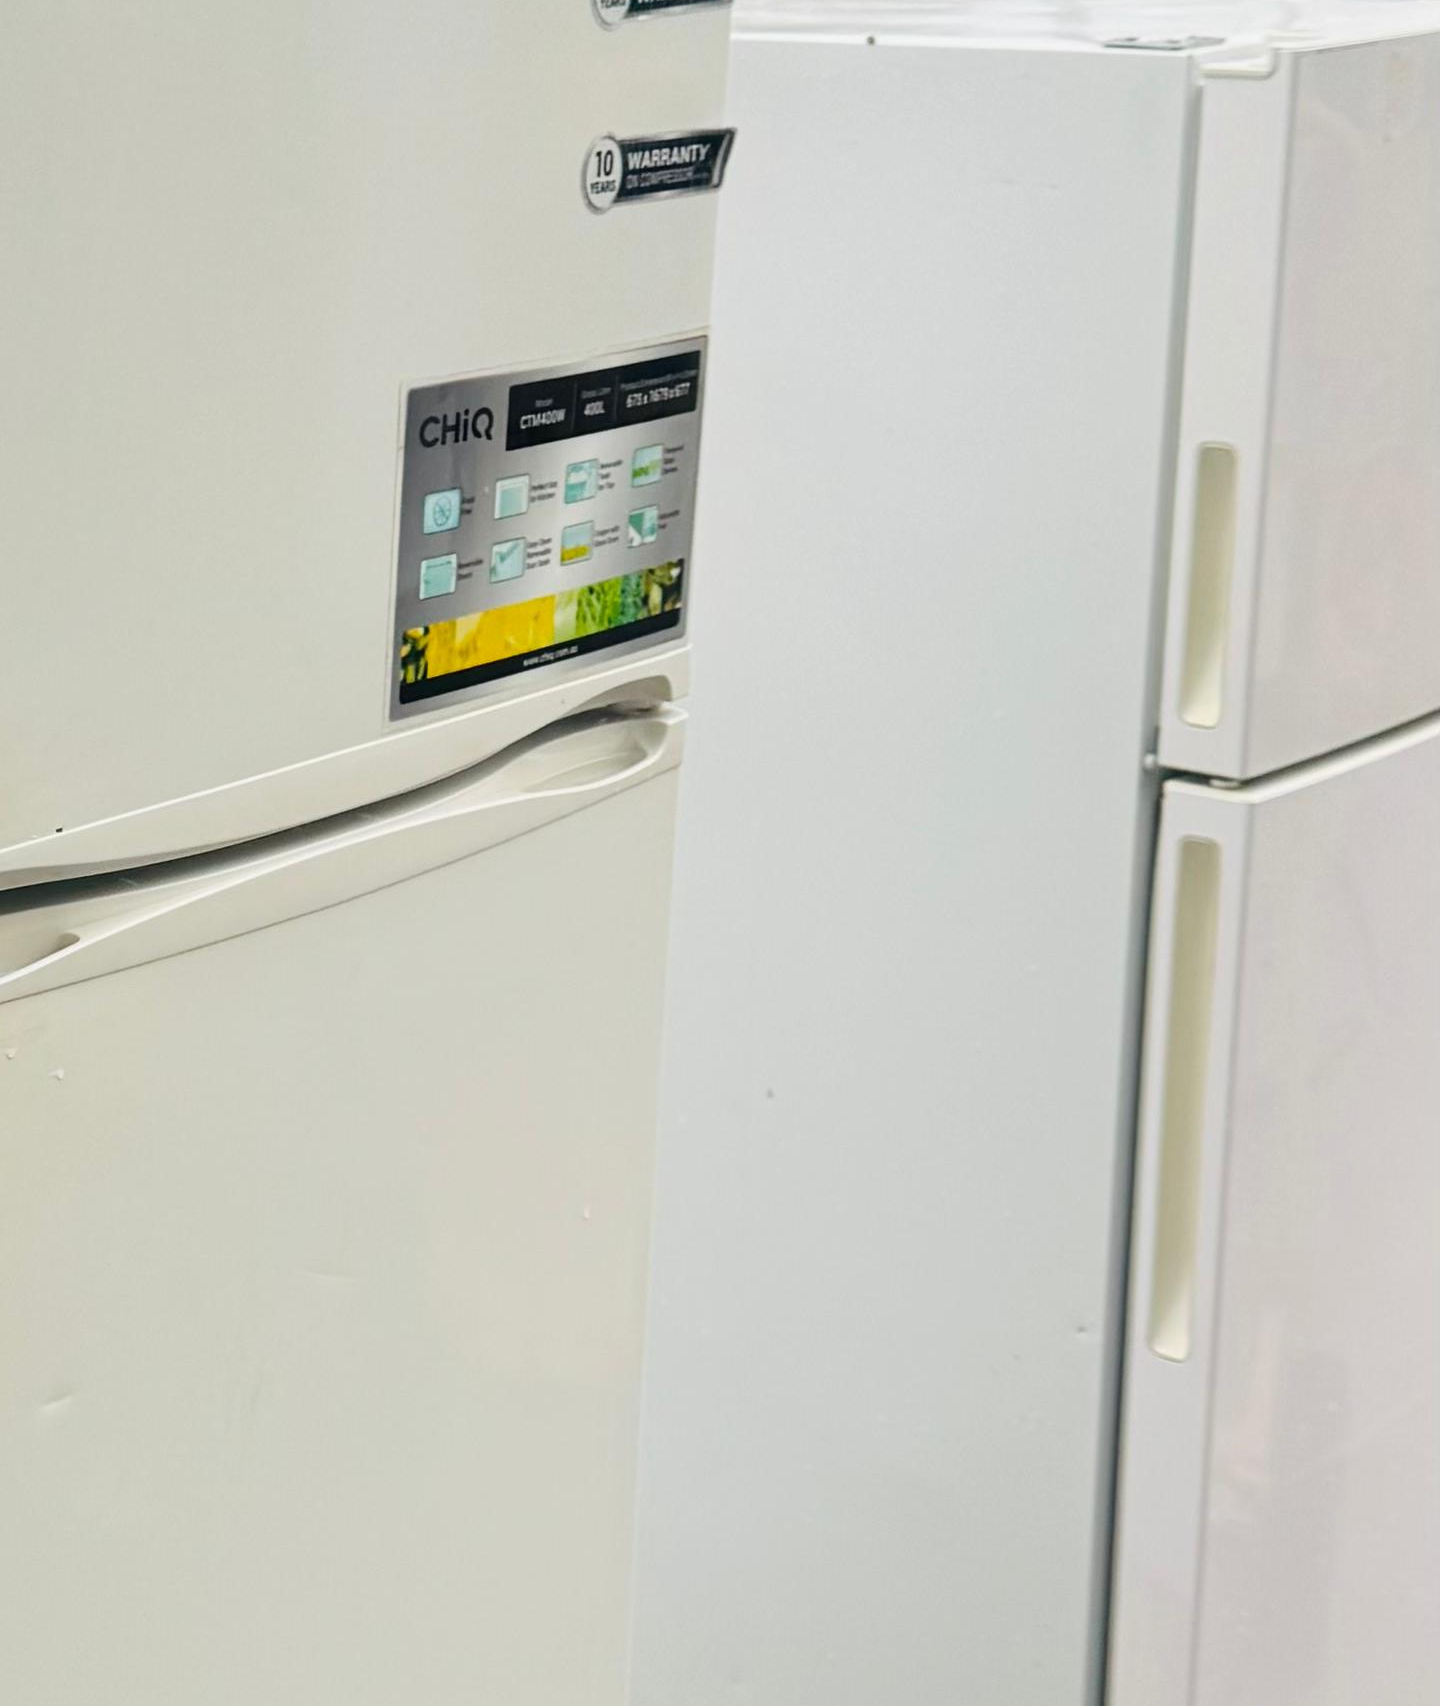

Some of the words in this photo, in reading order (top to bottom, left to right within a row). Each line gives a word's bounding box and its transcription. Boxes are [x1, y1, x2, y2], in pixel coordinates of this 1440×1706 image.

[596, 149, 615, 178] 10
[627, 143, 711, 170] WARRANTY
[590, 180, 617, 195] YEARS
[419, 407, 494, 448] CHiQ
